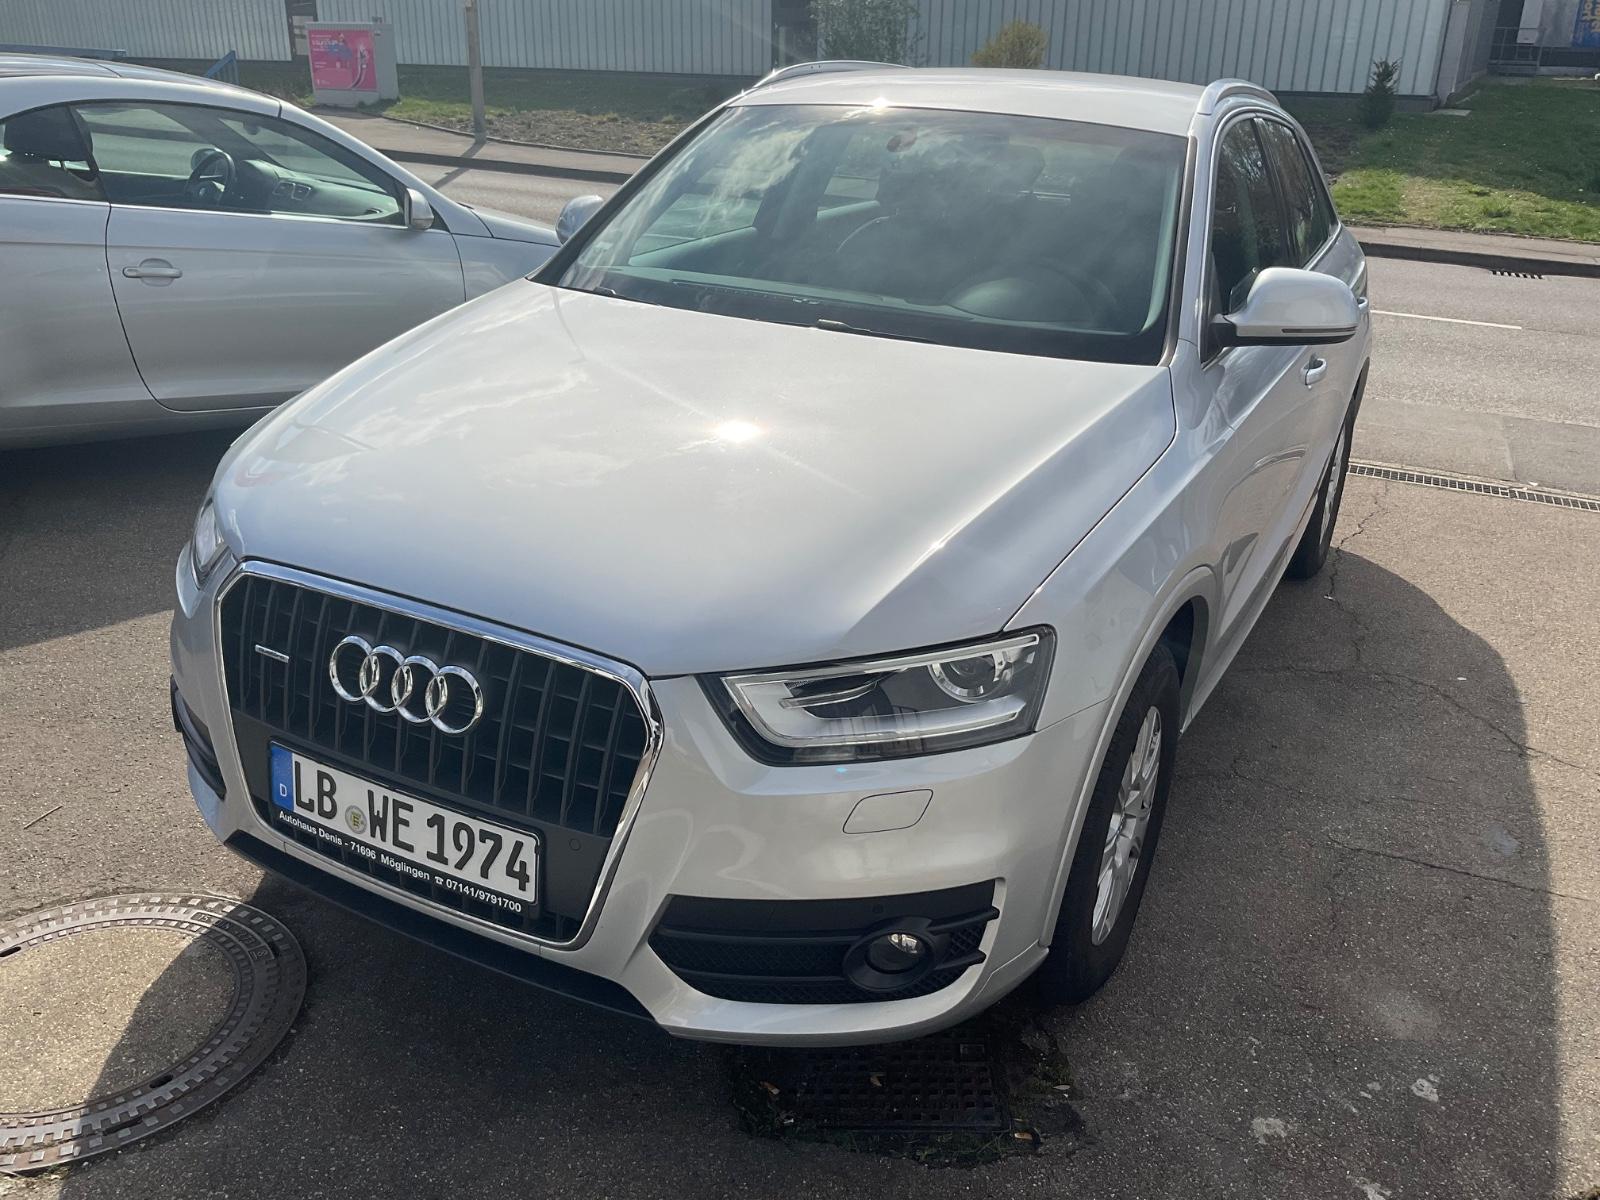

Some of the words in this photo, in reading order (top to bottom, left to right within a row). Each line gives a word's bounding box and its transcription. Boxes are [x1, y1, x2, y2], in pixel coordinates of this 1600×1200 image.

[280, 783, 287, 797] D
[294, 761, 338, 820] LB
[367, 789, 414, 853] WE
[426, 813, 530, 891] 1974
[279, 810, 317, 835] Autohaus
[318, 826, 342, 846] Denis
[350, 840, 376, 860] 71696
[381, 853, 430, 881] Möglingen
[446, 878, 522, 913] 07141/9791700
